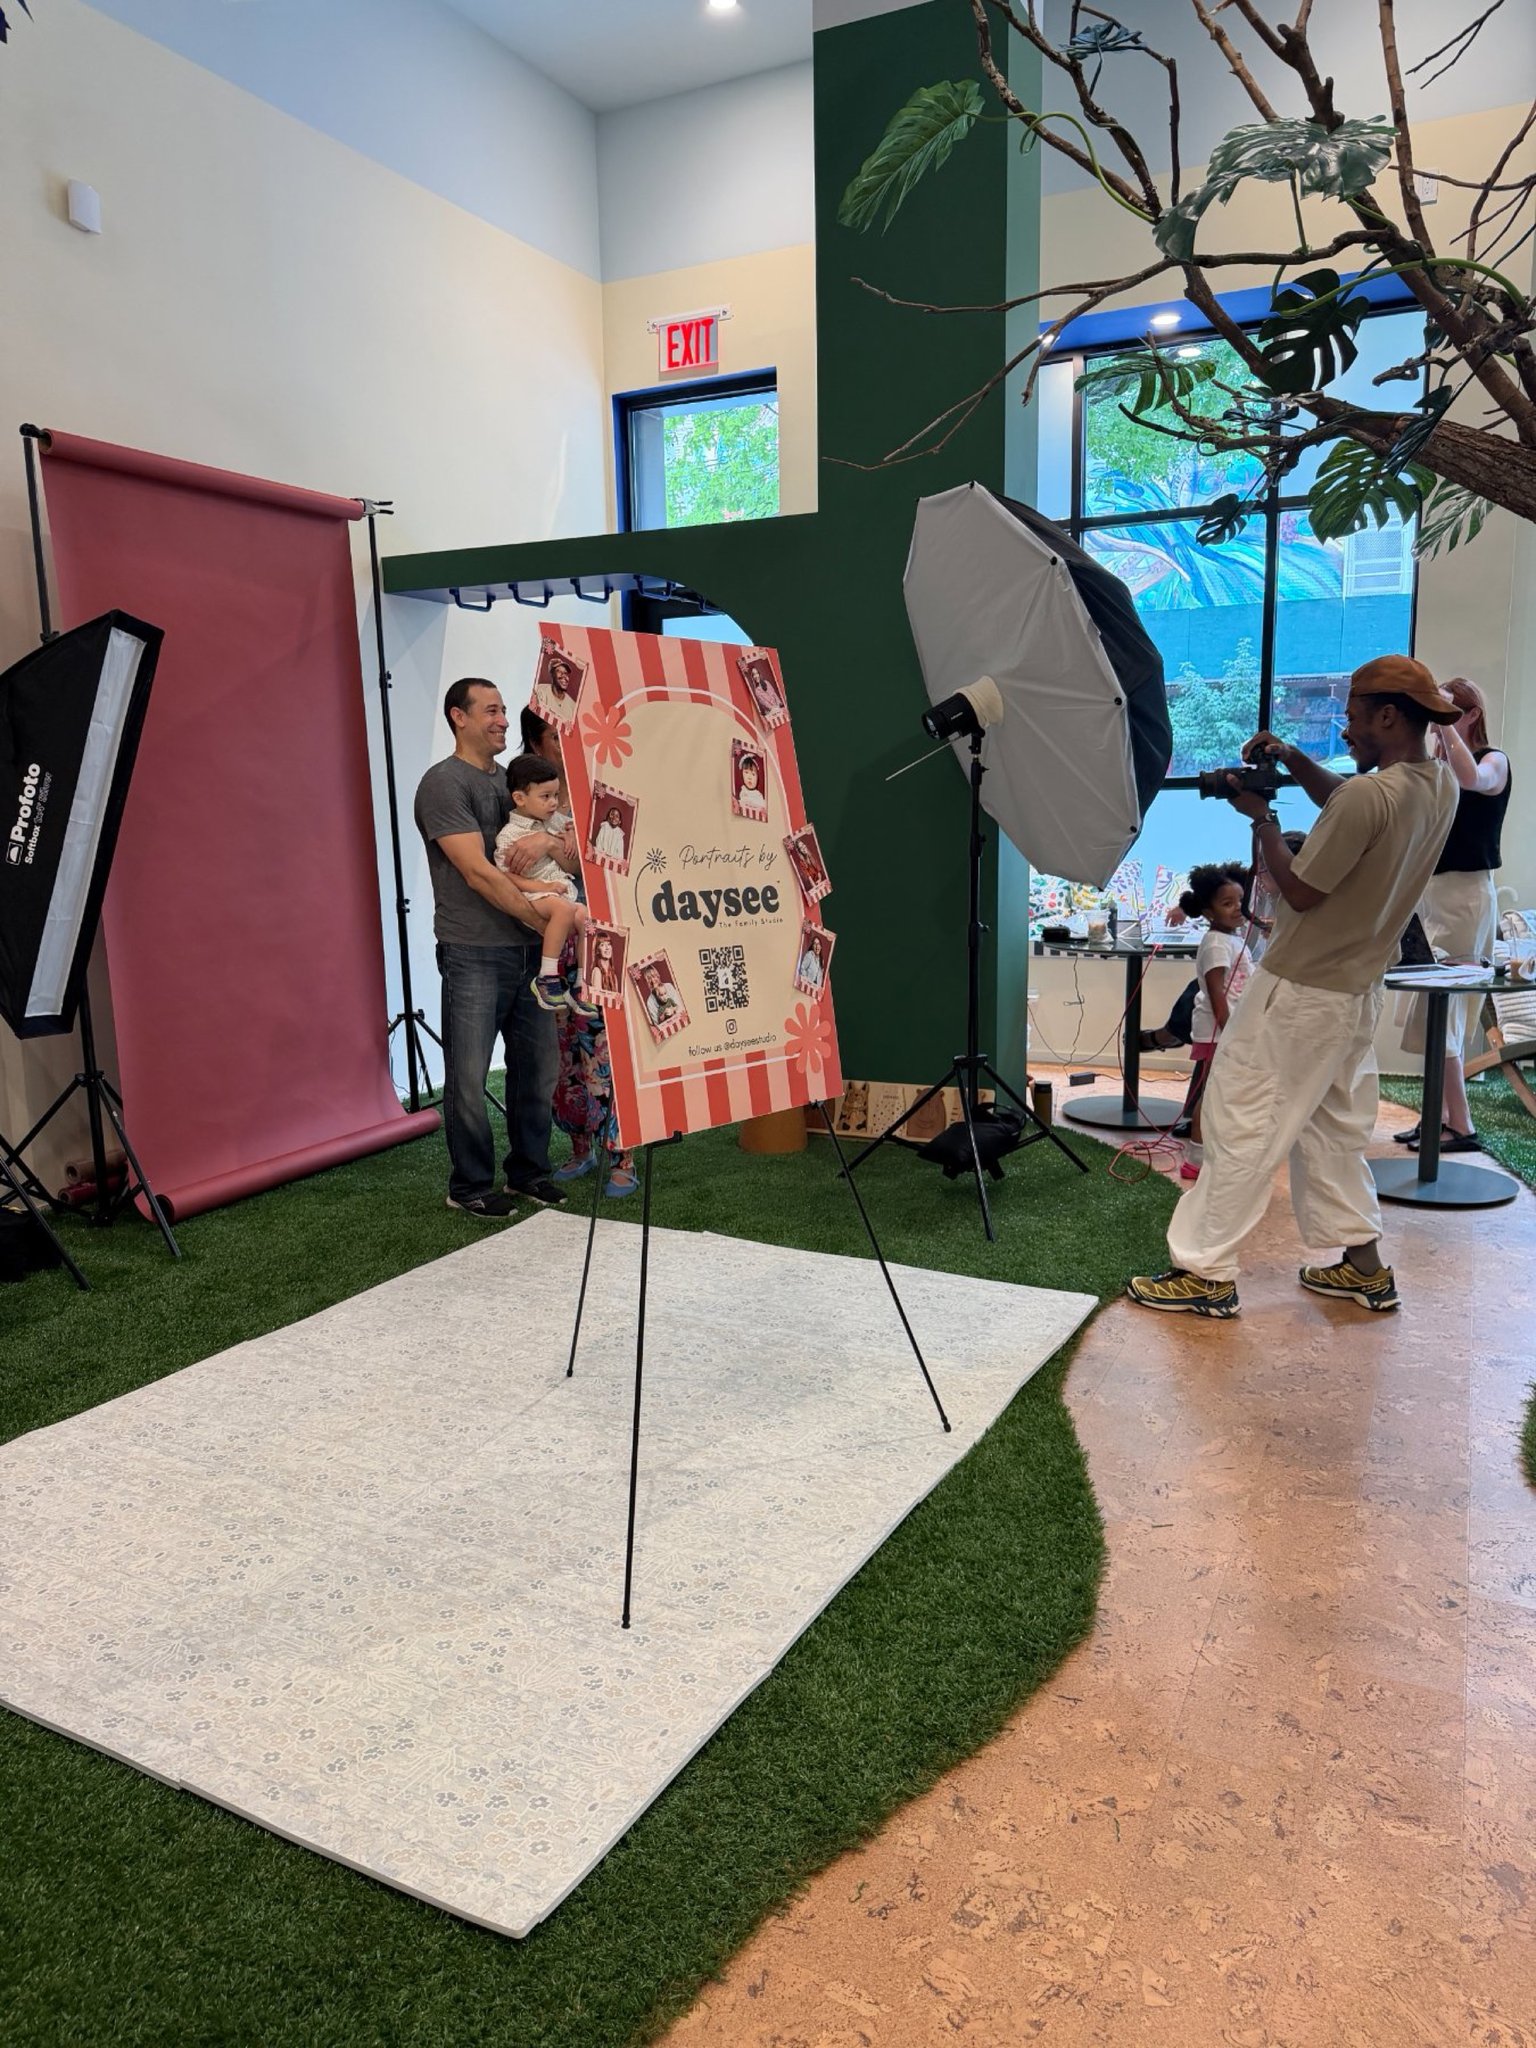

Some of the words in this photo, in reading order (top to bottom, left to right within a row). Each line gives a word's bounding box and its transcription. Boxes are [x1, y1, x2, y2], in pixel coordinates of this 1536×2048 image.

[667, 316, 714, 368] EXIT
[10, 763, 41, 843] Profoto
[24, 825, 41, 864] Softbox
[679, 844, 754, 870] Portraits
[758, 843, 777, 871] by
[651, 879, 780, 929] daysee
[688, 1045, 712, 1057] follow
[714, 1044, 722, 1053] us
[724, 1032, 777, 1051] @dayseestudio
